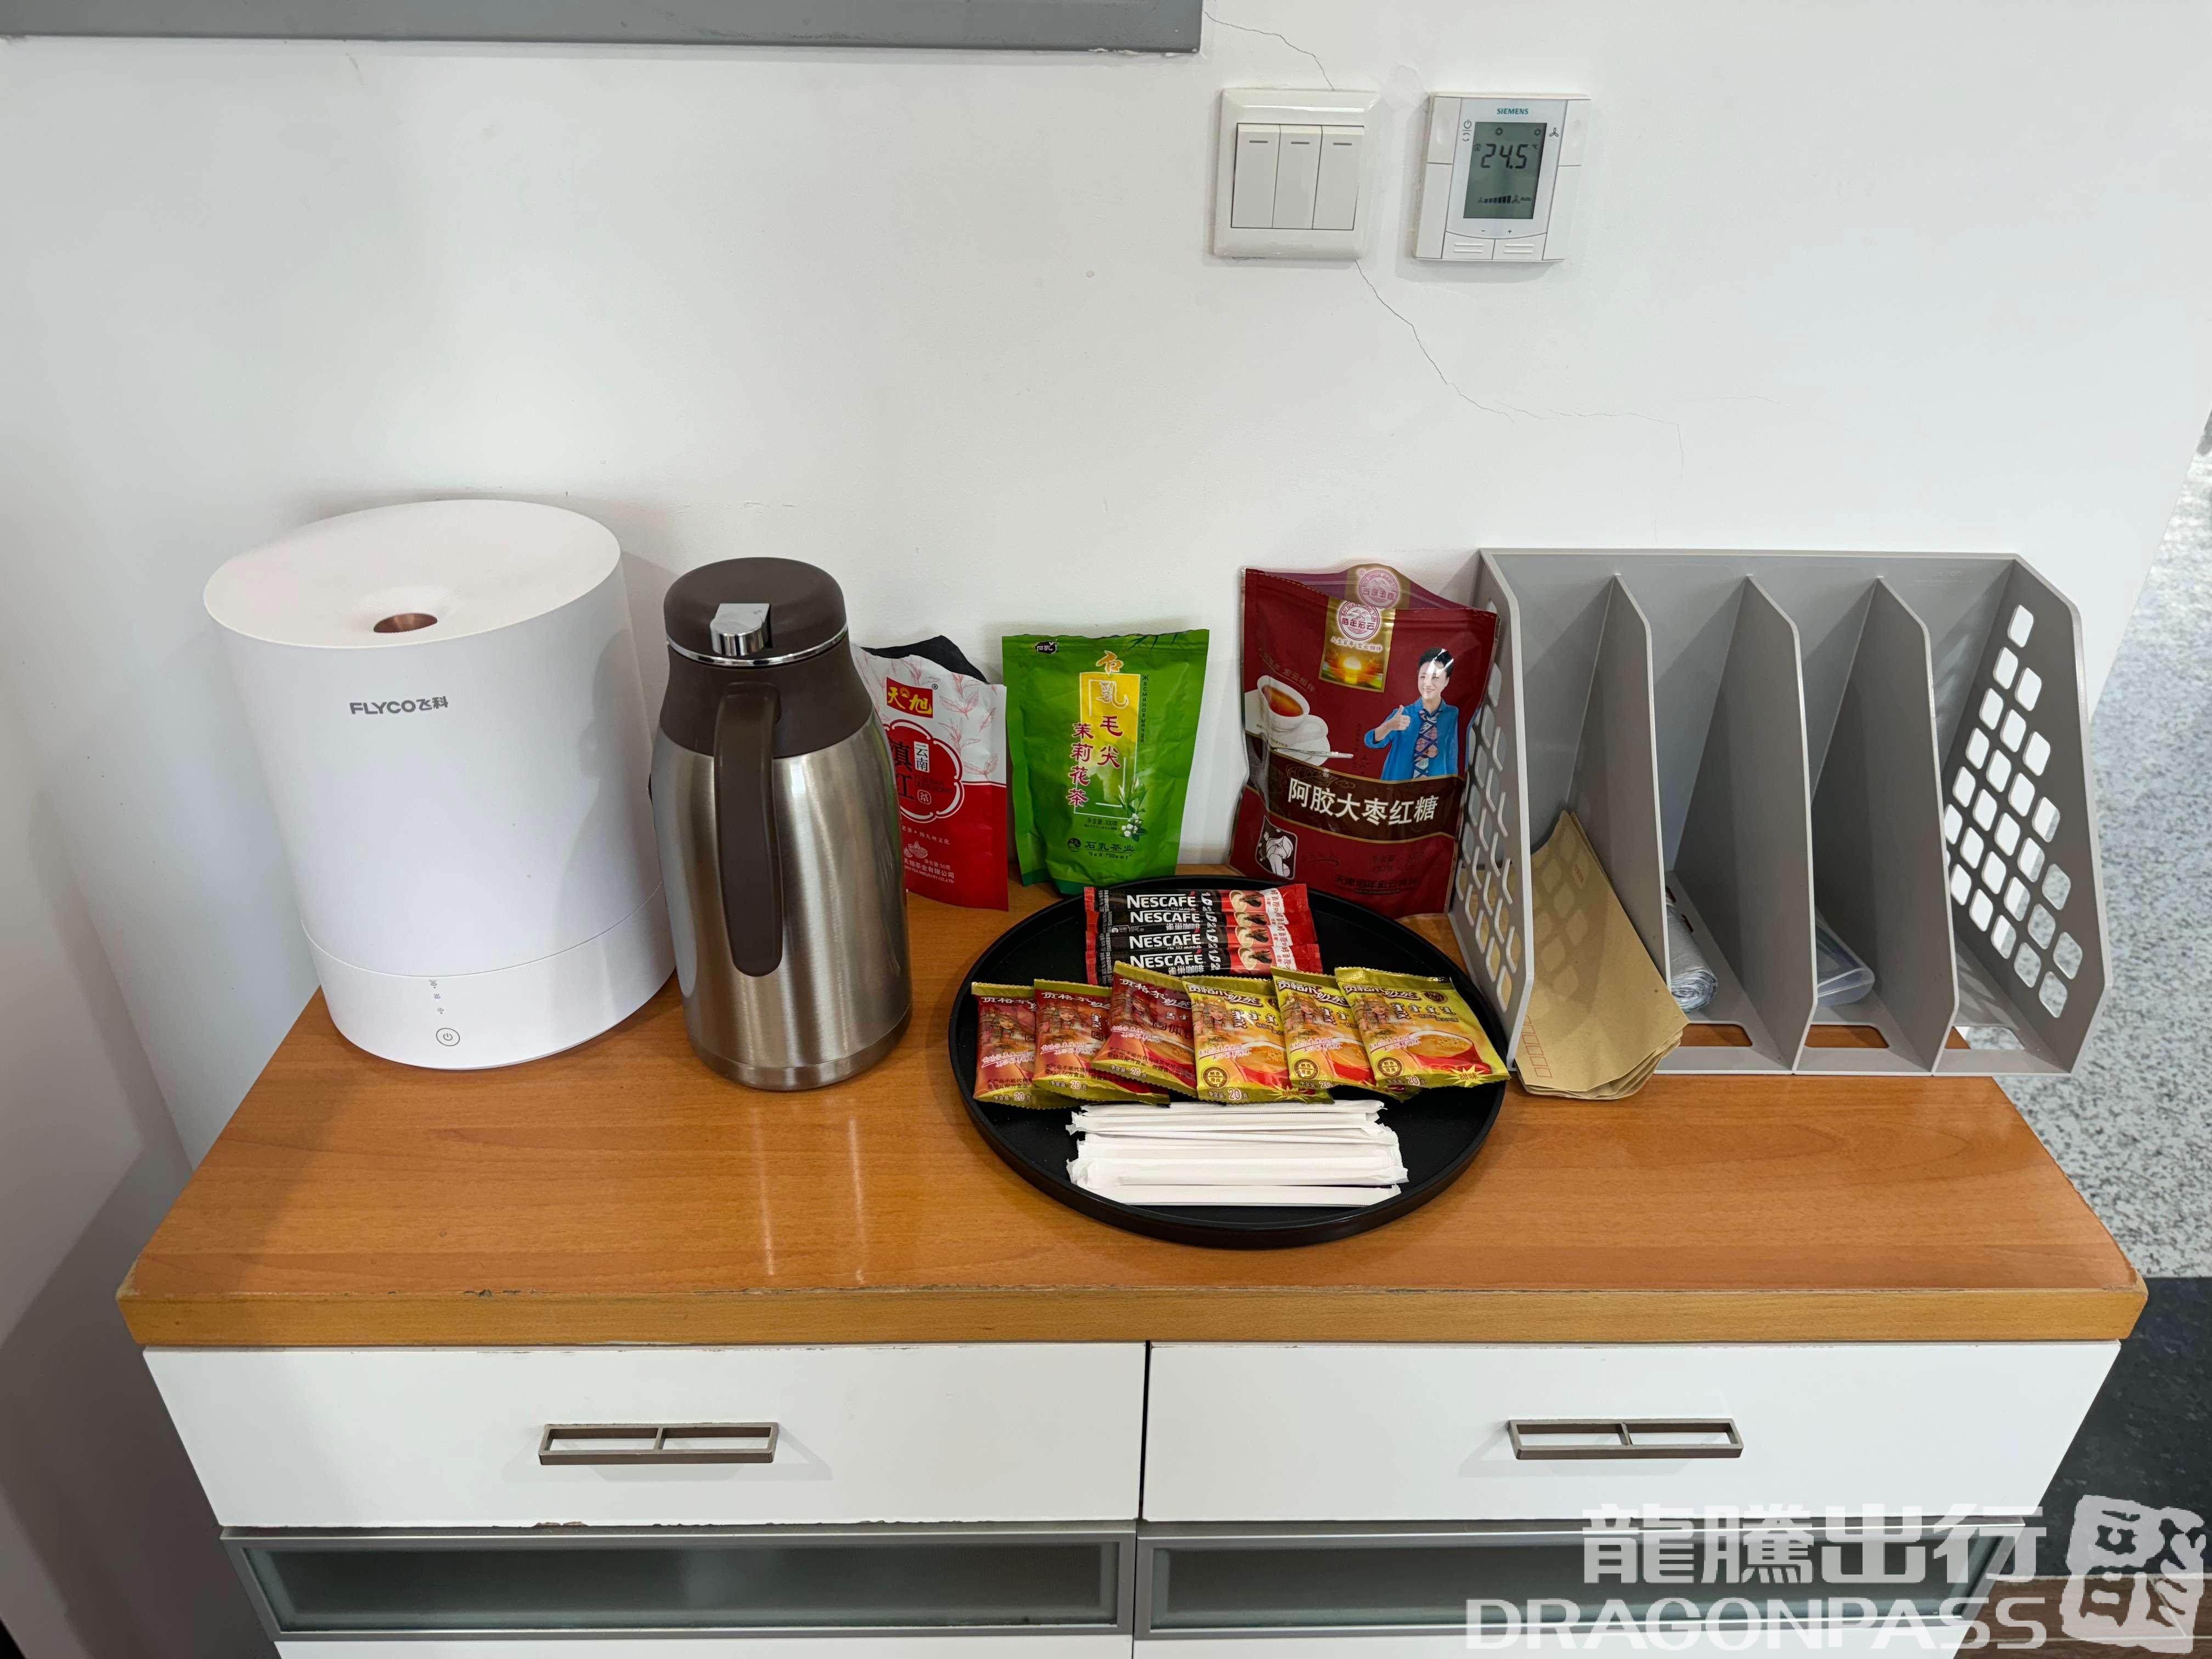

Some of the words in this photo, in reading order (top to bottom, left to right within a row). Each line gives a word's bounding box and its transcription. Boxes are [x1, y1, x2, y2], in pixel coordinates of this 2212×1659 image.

[1480, 143, 1529, 169] 24.5
[1342, 618, 1375, 630] 佰年宏云
[349, 699, 416, 714] FLYCO
[416, 696, 448, 711] 飞科
[887, 686, 933, 715] 天旭
[915, 743, 928, 772] 云南
[1066, 723, 1094, 808] 茉莉花茶
[1288, 777, 1439, 826] 阿胶大枣红糖
[1084, 841, 1135, 851] 石乳茶业
[1168, 964, 1205, 975] 雀巢咖啡
[1459, 1073, 1479, 1081] 甜味
